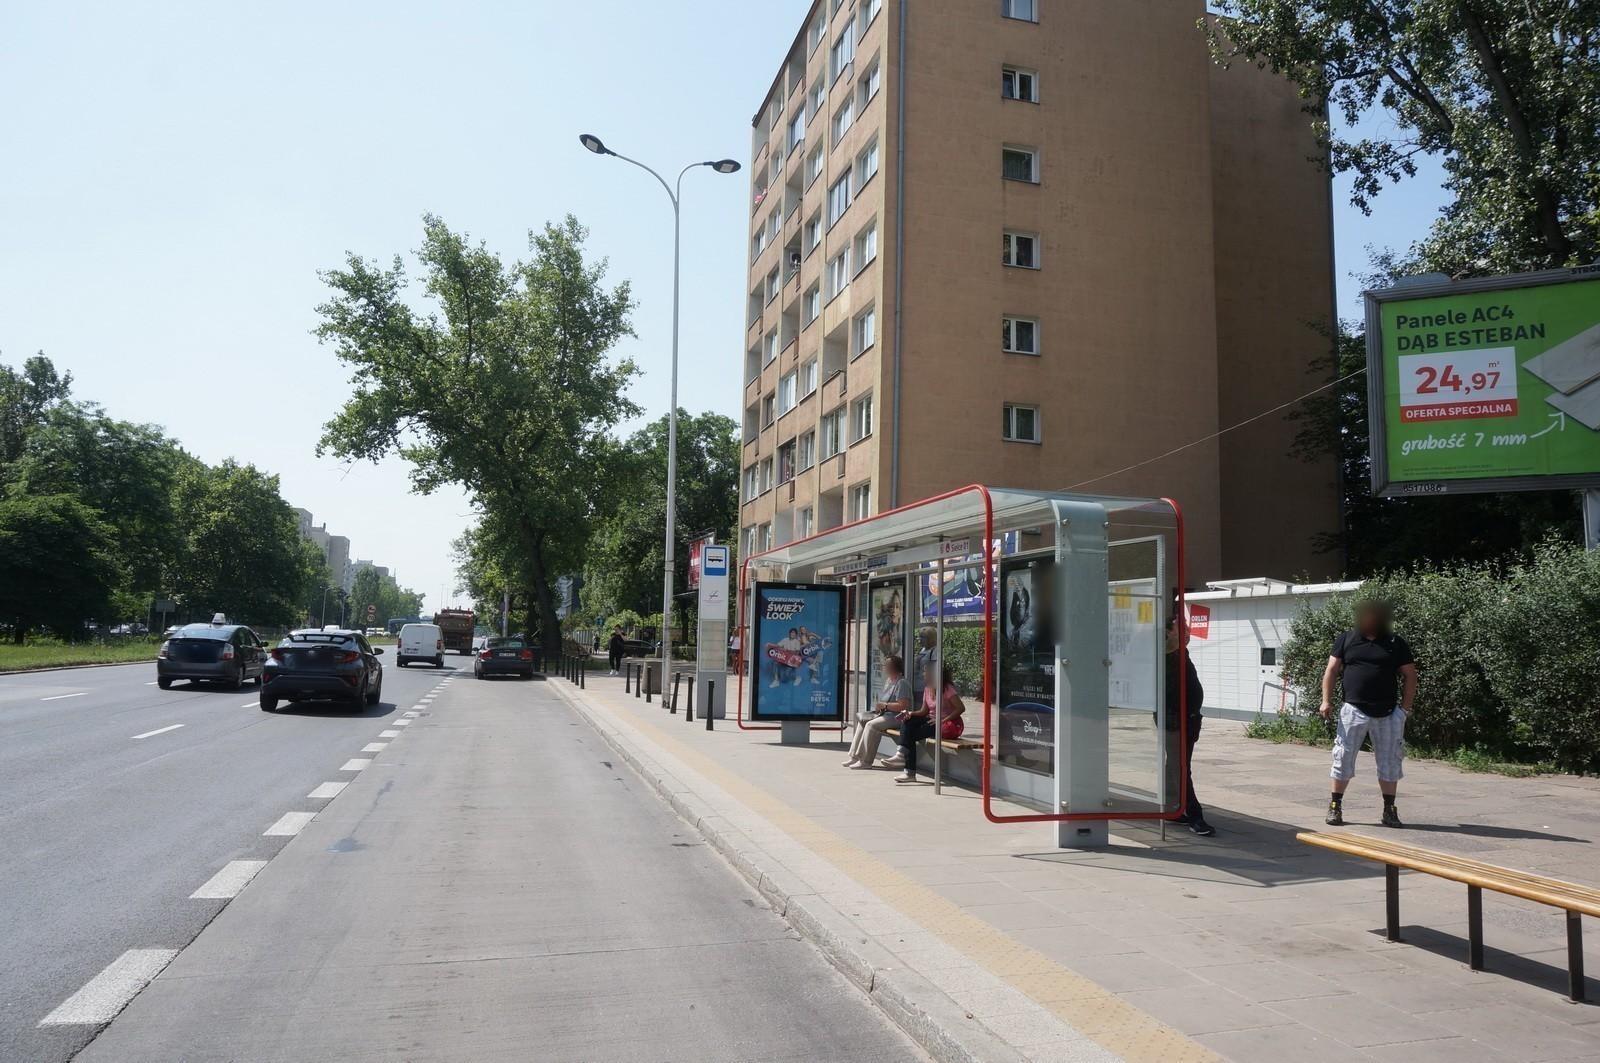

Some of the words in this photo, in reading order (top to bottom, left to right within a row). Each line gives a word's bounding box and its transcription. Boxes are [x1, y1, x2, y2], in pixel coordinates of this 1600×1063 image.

[1396, 309, 1467, 329] Panele
[1471, 305, 1514, 323] AC4
[1397, 333, 1438, 352] DĄB
[1445, 323, 1545, 346] ESTEBAN
[1415, 365, 1500, 395] 24,97
[1406, 408, 1447, 419] OFERTA
[1448, 403, 1513, 416] SPECJALNA
[1401, 433, 1466, 456] grubość
[1474, 432, 1484, 447] 7
[1492, 434, 1527, 446] mm
[767, 602, 804, 613] ŚWIEŻY
[767, 612, 792, 620] LOOK
[769, 649, 786, 661] Orbit
[803, 644, 819, 656] Orbit
